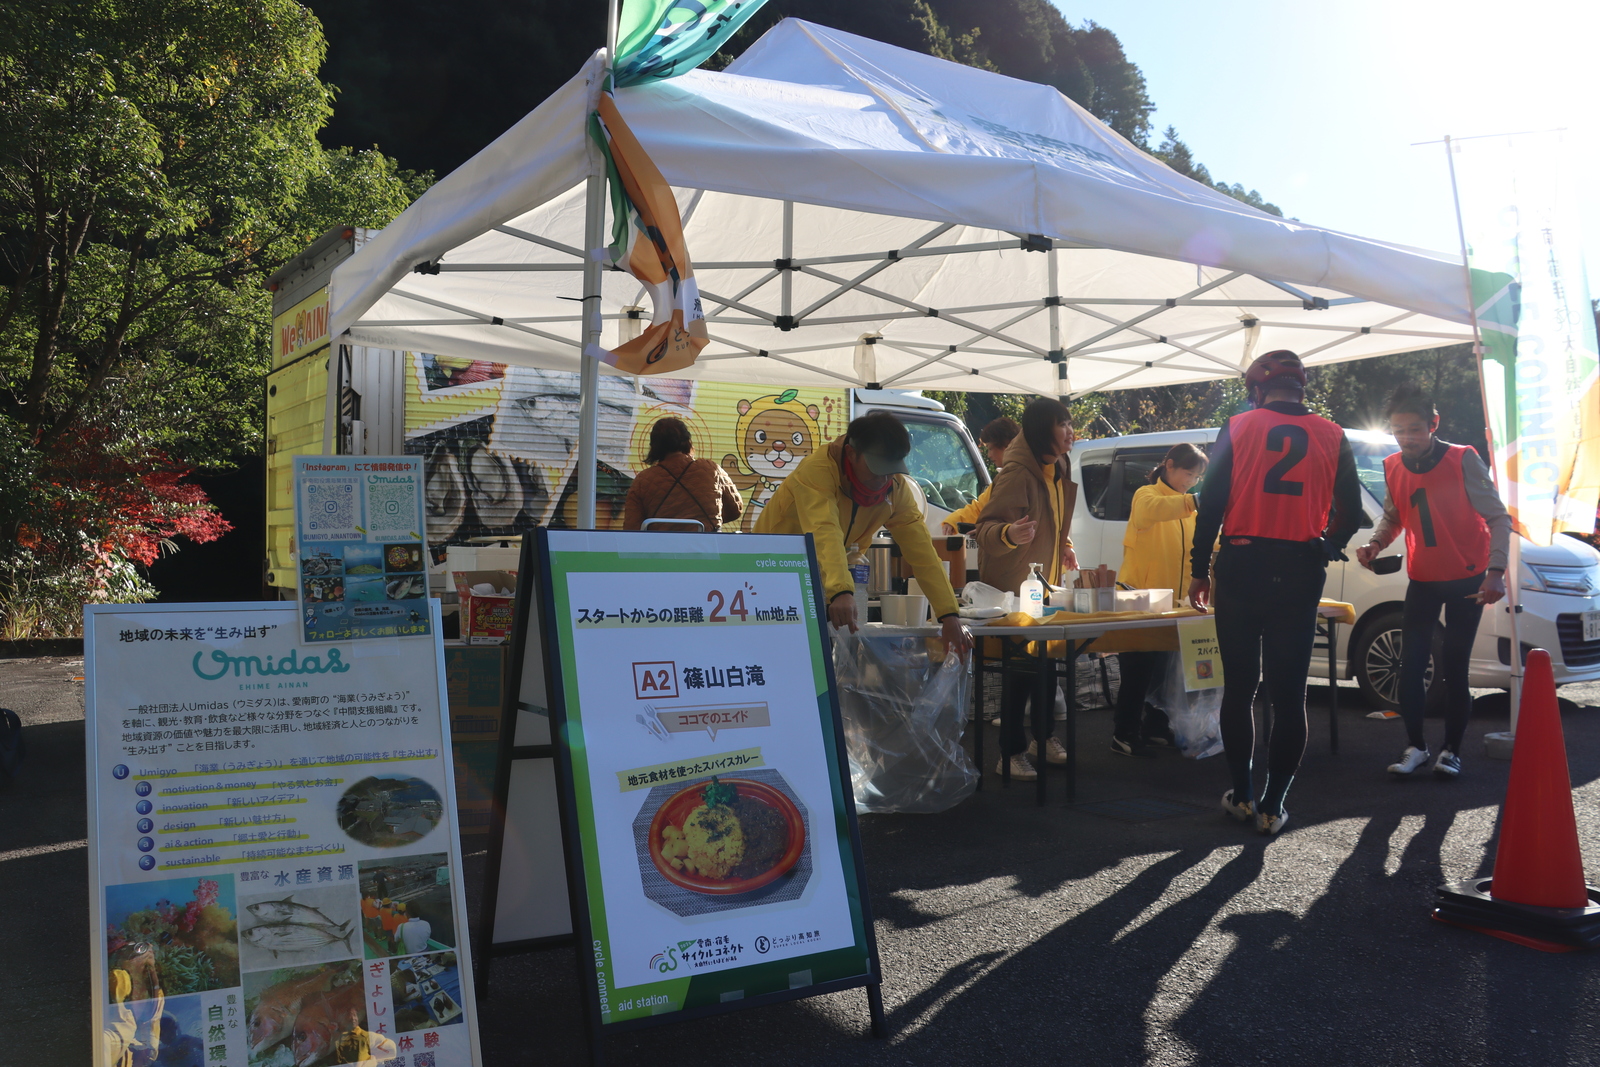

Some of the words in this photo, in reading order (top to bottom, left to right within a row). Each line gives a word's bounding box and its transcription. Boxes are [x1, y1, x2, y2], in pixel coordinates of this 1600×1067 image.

[1263, 424, 1309, 496] 2
[1409, 487, 1437, 547] 1
[755, 558, 776, 568] cycle
[578, 606, 704, 624] スタートからの距離
[706, 589, 748, 623] 24
[805, 589, 817, 619] station
[239, 683, 270, 691] EHIME
[278, 681, 309, 689] AINAN
[641, 668, 671, 692] A2
[683, 664, 766, 690] 篠山白滝
[678, 710, 749, 726] ココでのエイド
[139, 768, 178, 778] Umigyo
[627, 753, 760, 787] 地元食材を使ったスパイスカレー
[162, 801, 208, 812] inovation
[163, 821, 196, 831] design
[165, 854, 221, 867] sustainable
[240, 870, 270, 882] 豊富な
[274, 864, 355, 887] 水産資源
[593, 939, 604, 967] cycle
[595, 971, 612, 1015] connect
[618, 998, 634, 1012] aid
[636, 992, 669, 1008] station
[208, 1004, 229, 1067] 自然環
